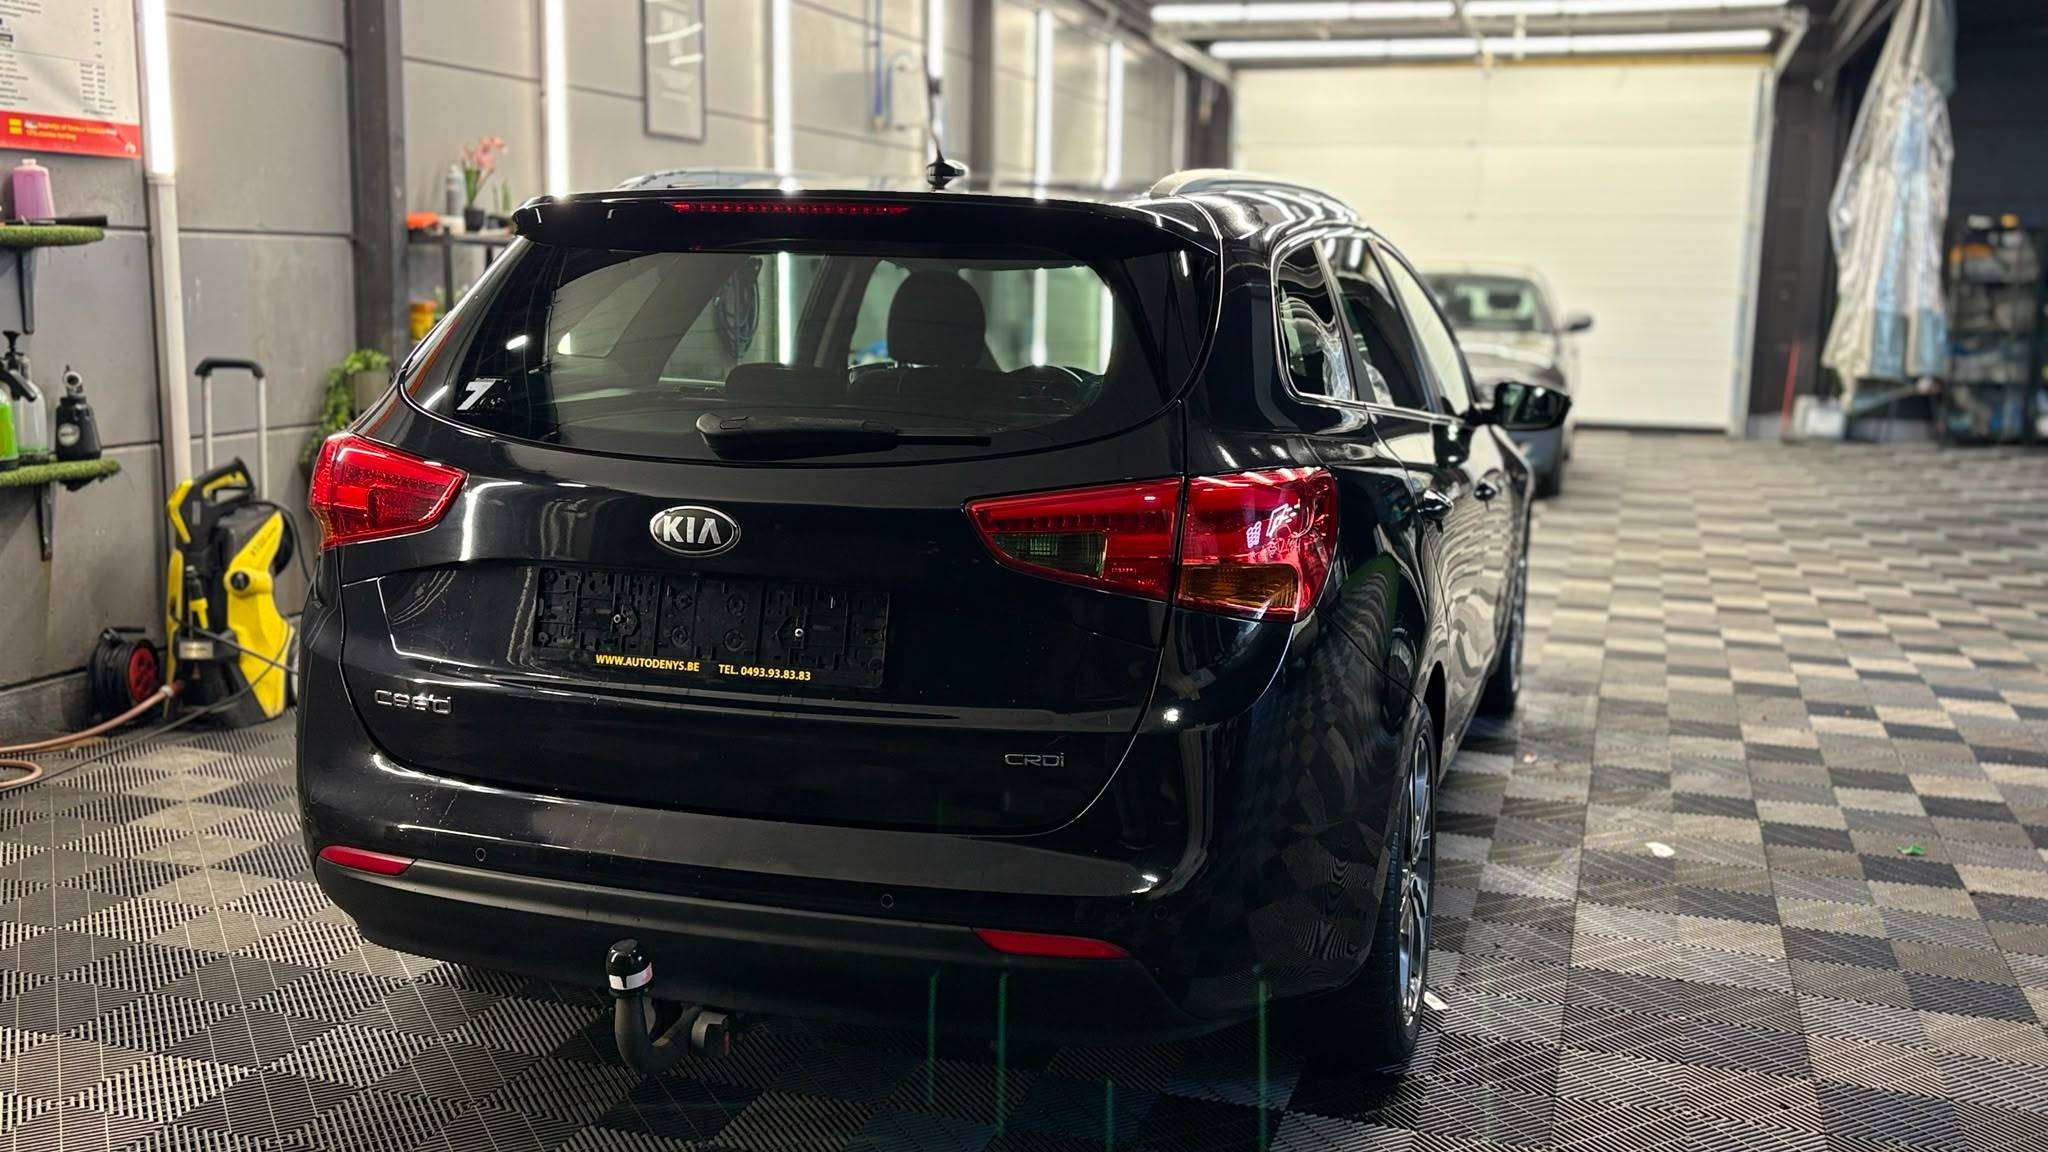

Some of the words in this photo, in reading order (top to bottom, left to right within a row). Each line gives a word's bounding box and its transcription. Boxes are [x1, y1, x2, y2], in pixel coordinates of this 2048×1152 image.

[663, 515, 721, 545] KIA
[595, 654, 700, 672] WWW.AUTODENYS.BE
[718, 663, 738, 676] TEL.
[740, 666, 811, 681] 0493.93.83.83
